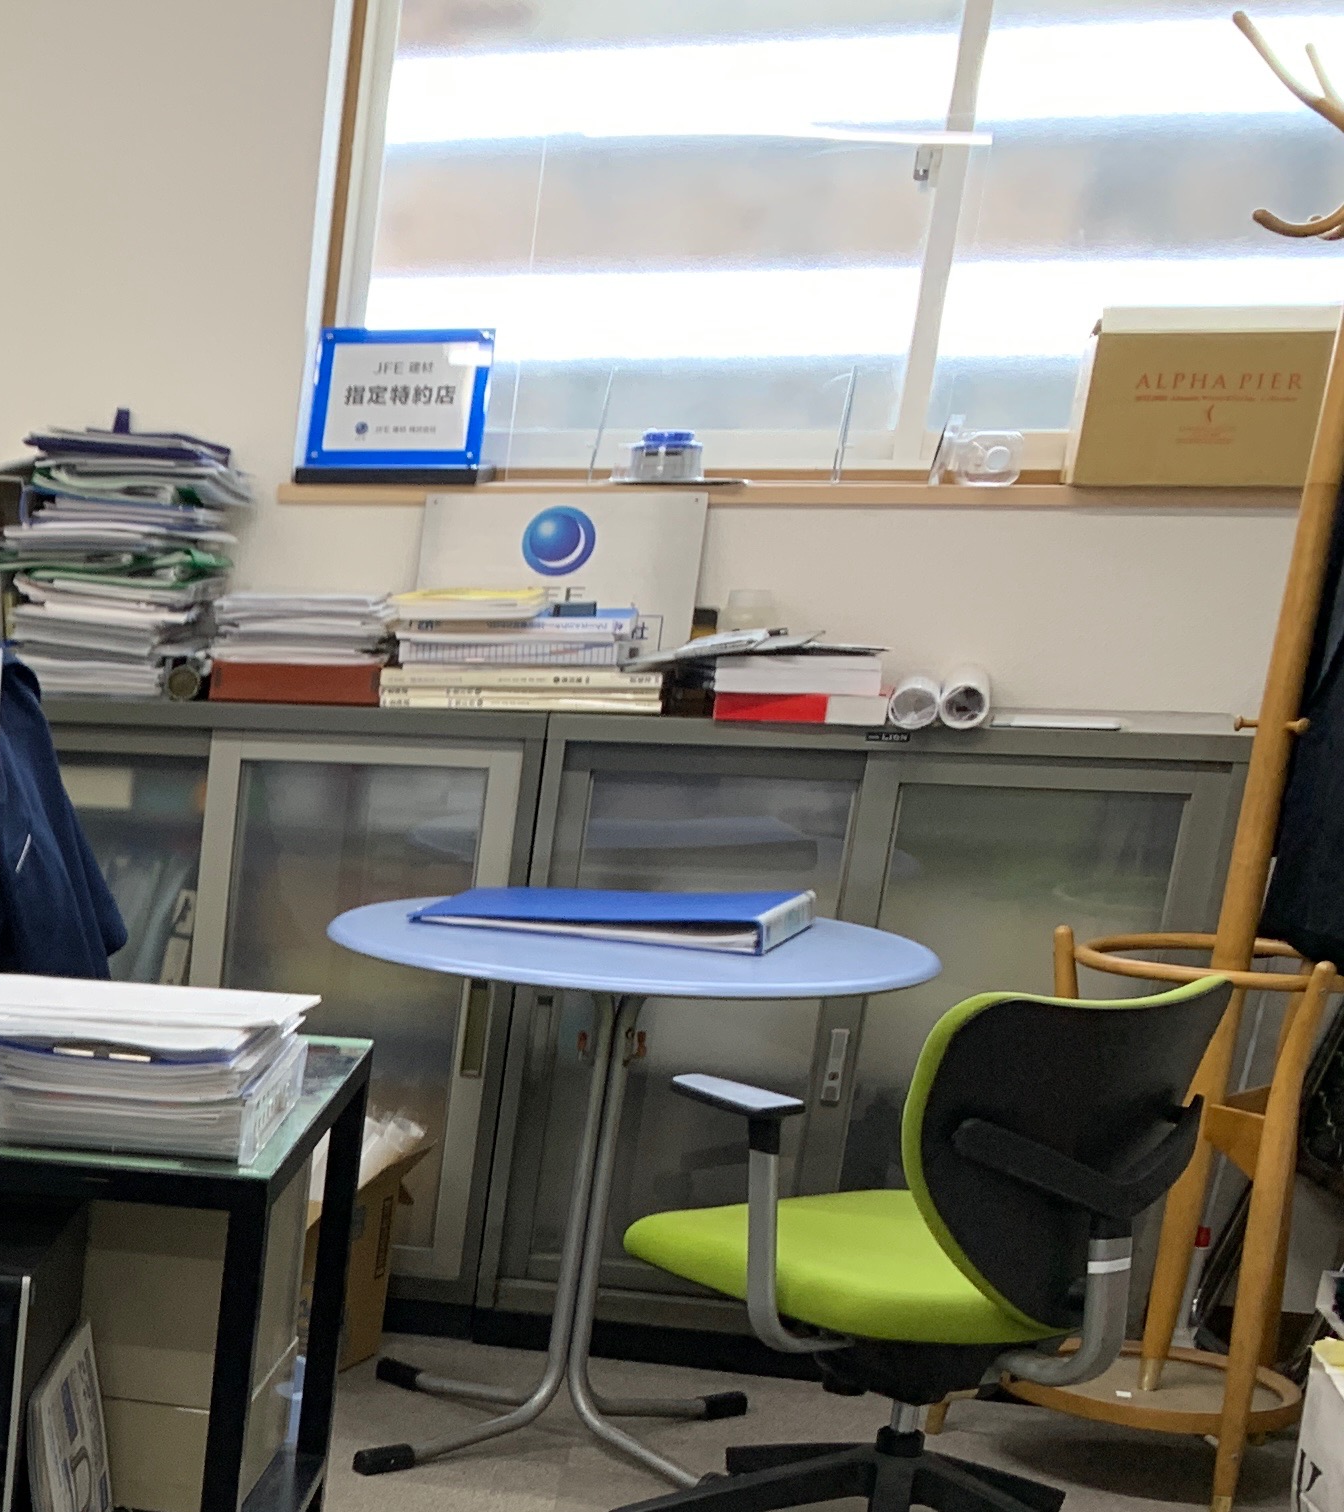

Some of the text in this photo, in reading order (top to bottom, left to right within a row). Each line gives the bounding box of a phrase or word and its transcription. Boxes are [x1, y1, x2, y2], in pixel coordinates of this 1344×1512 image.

[1136, 373, 1303, 390] ALPHA PIER
[344, 385, 457, 406] 指定特約店
